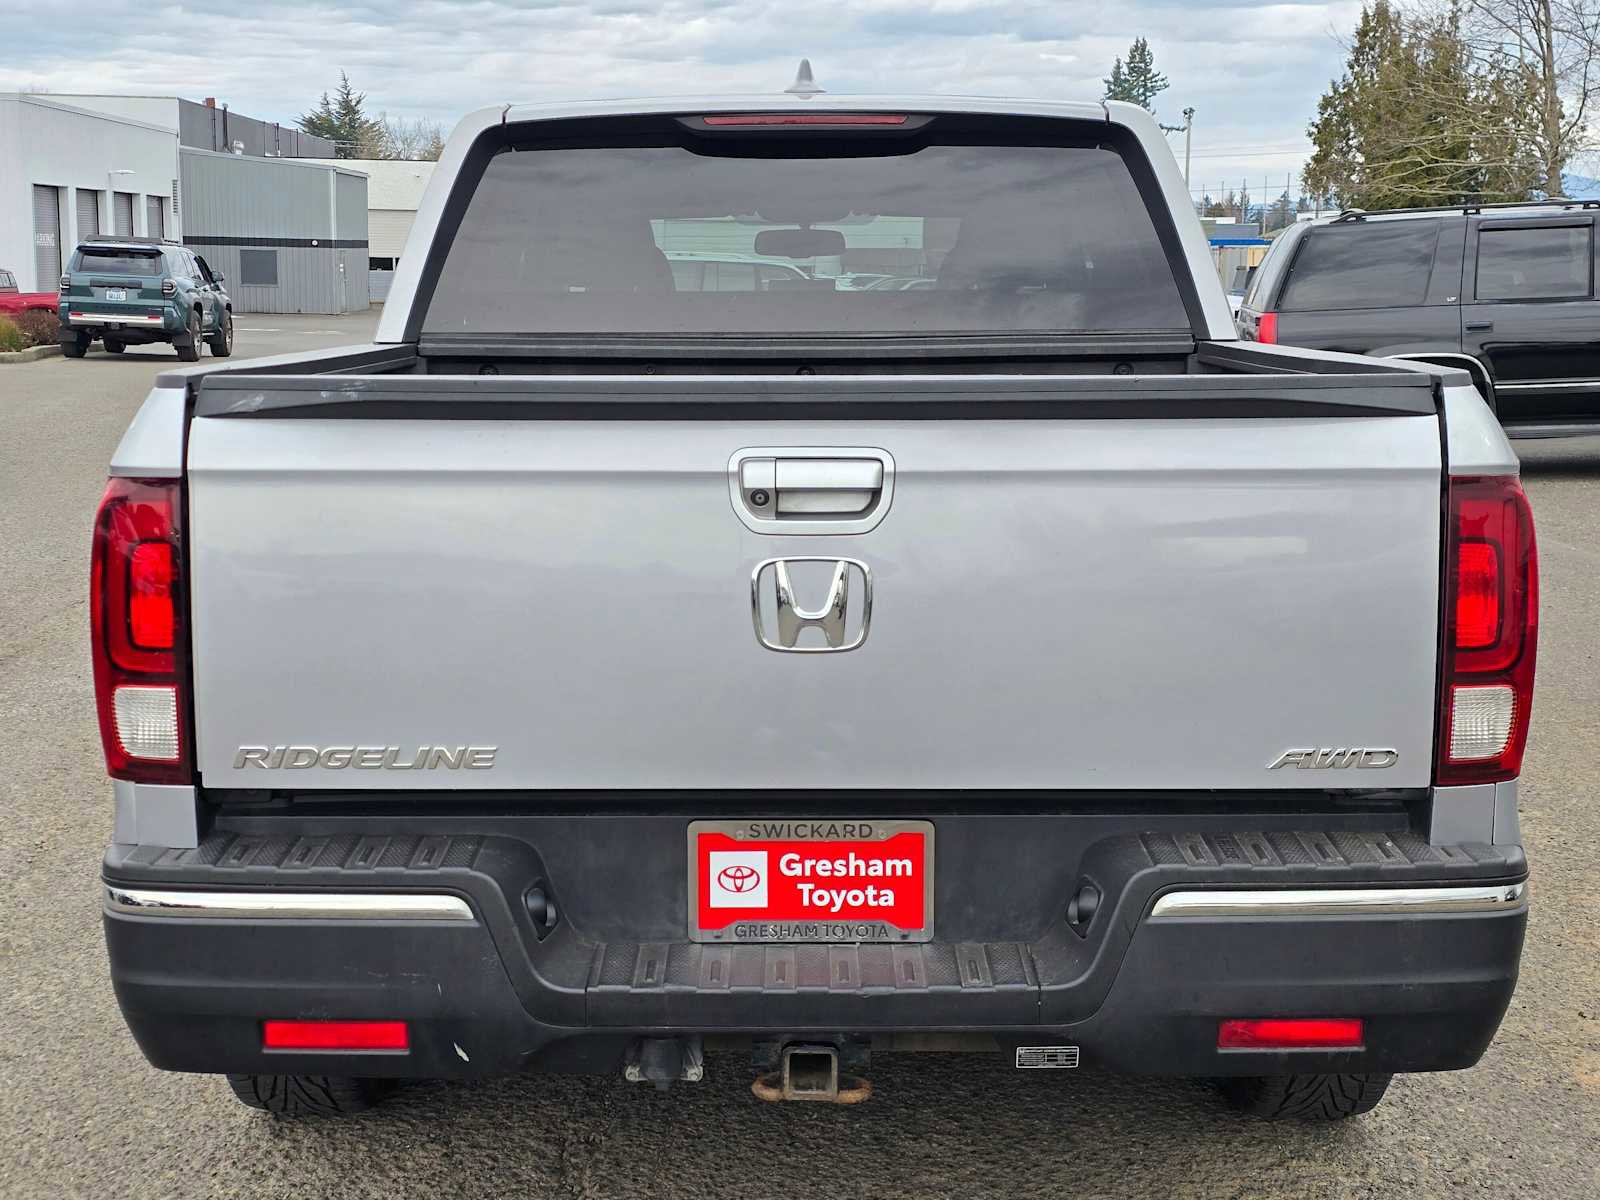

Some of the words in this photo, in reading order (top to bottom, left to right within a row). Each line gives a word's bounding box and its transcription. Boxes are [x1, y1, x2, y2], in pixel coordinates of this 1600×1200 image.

[233, 745, 498, 769] RIDGELINE
[1265, 747, 1399, 769] AWD
[749, 823, 873, 839] SWICKARD
[779, 852, 913, 877] Gresham
[797, 883, 895, 912] Toyota
[734, 924, 818, 939] GRESHAM
[822, 924, 889, 939] TOYOTA
